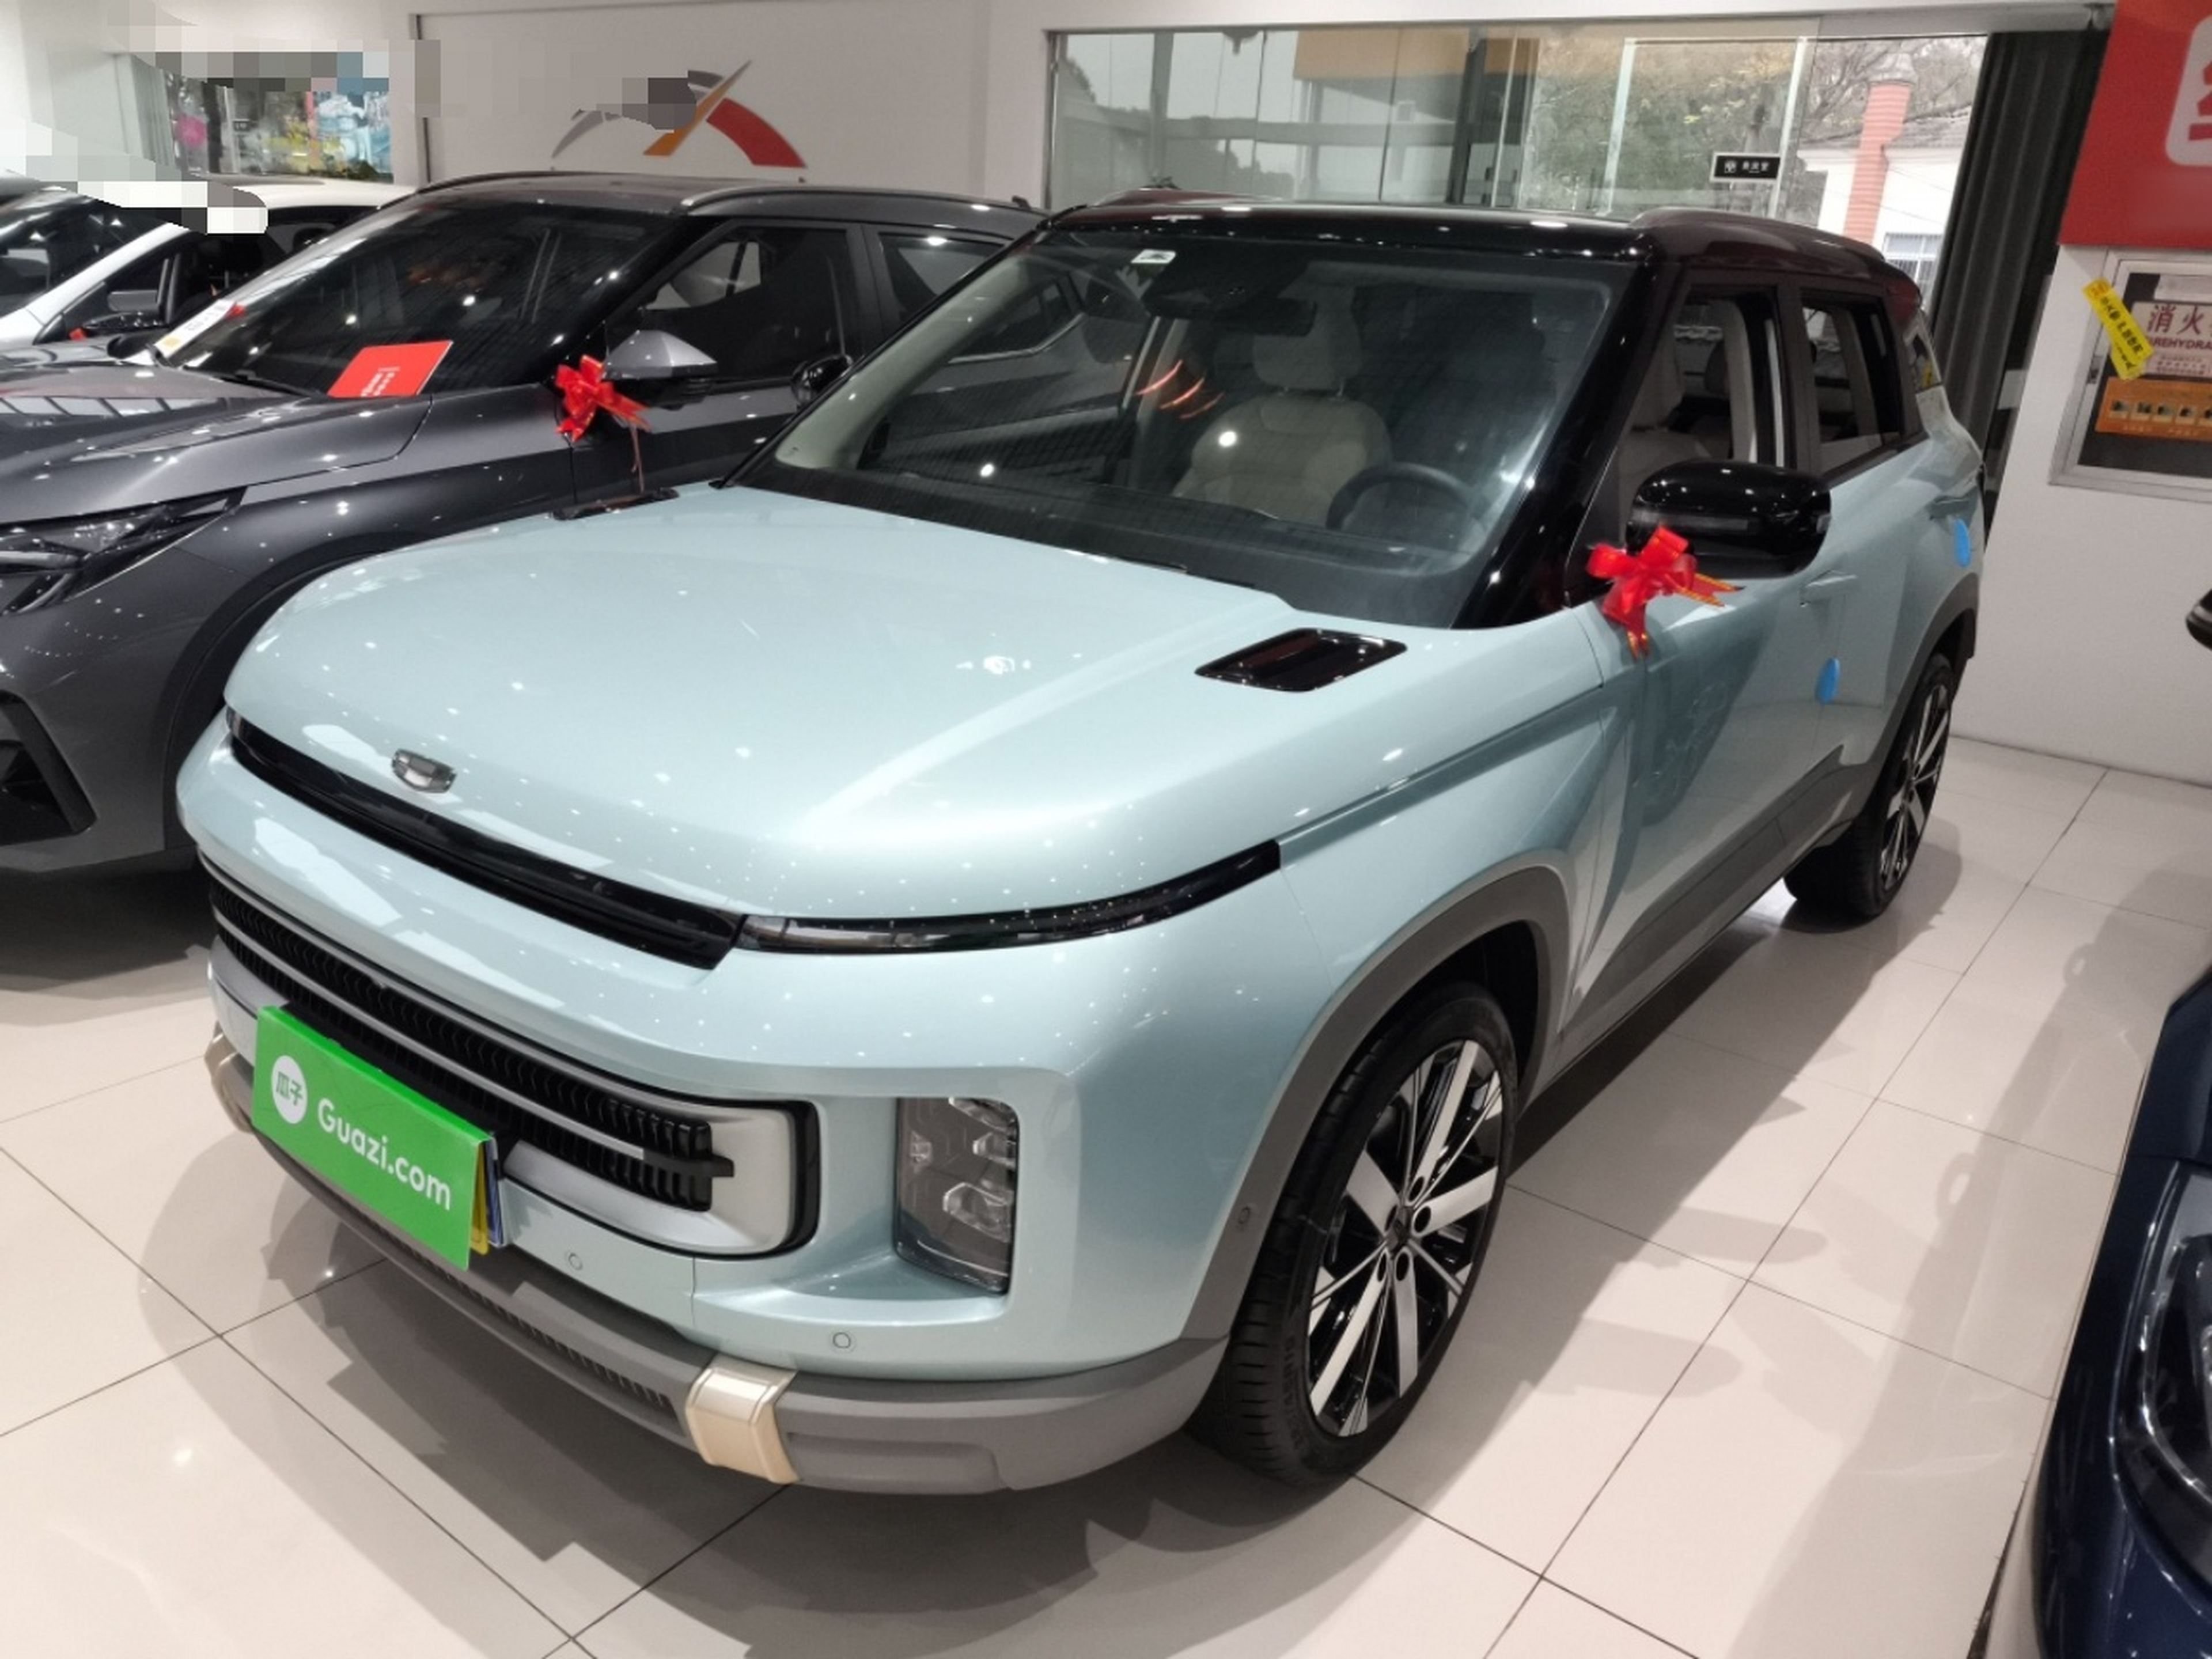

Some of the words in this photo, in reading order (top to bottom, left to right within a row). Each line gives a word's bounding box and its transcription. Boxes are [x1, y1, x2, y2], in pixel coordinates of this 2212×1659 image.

[2147, 304, 2212, 335] 消火
[276, 1071, 303, 1107] 瓜子
[317, 1098, 451, 1211] Guazi.com
